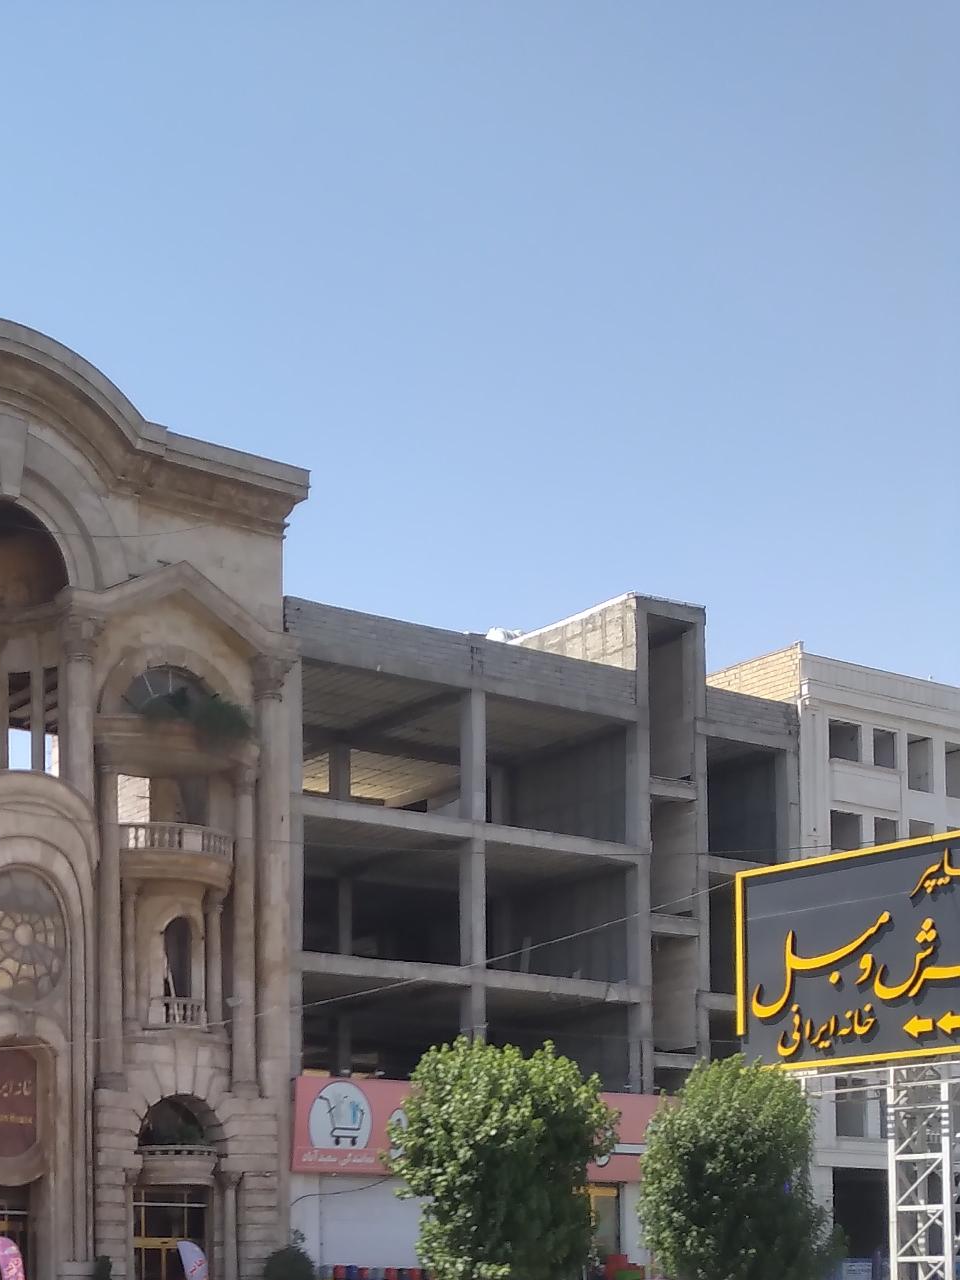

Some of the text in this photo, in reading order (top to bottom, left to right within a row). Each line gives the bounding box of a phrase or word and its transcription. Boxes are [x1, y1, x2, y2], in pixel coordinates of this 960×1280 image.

[909, 847, 960, 899] ایپر
[751, 911, 960, 1019] رش و مبل
[776, 1002, 877, 1057] خانه ایرانی
